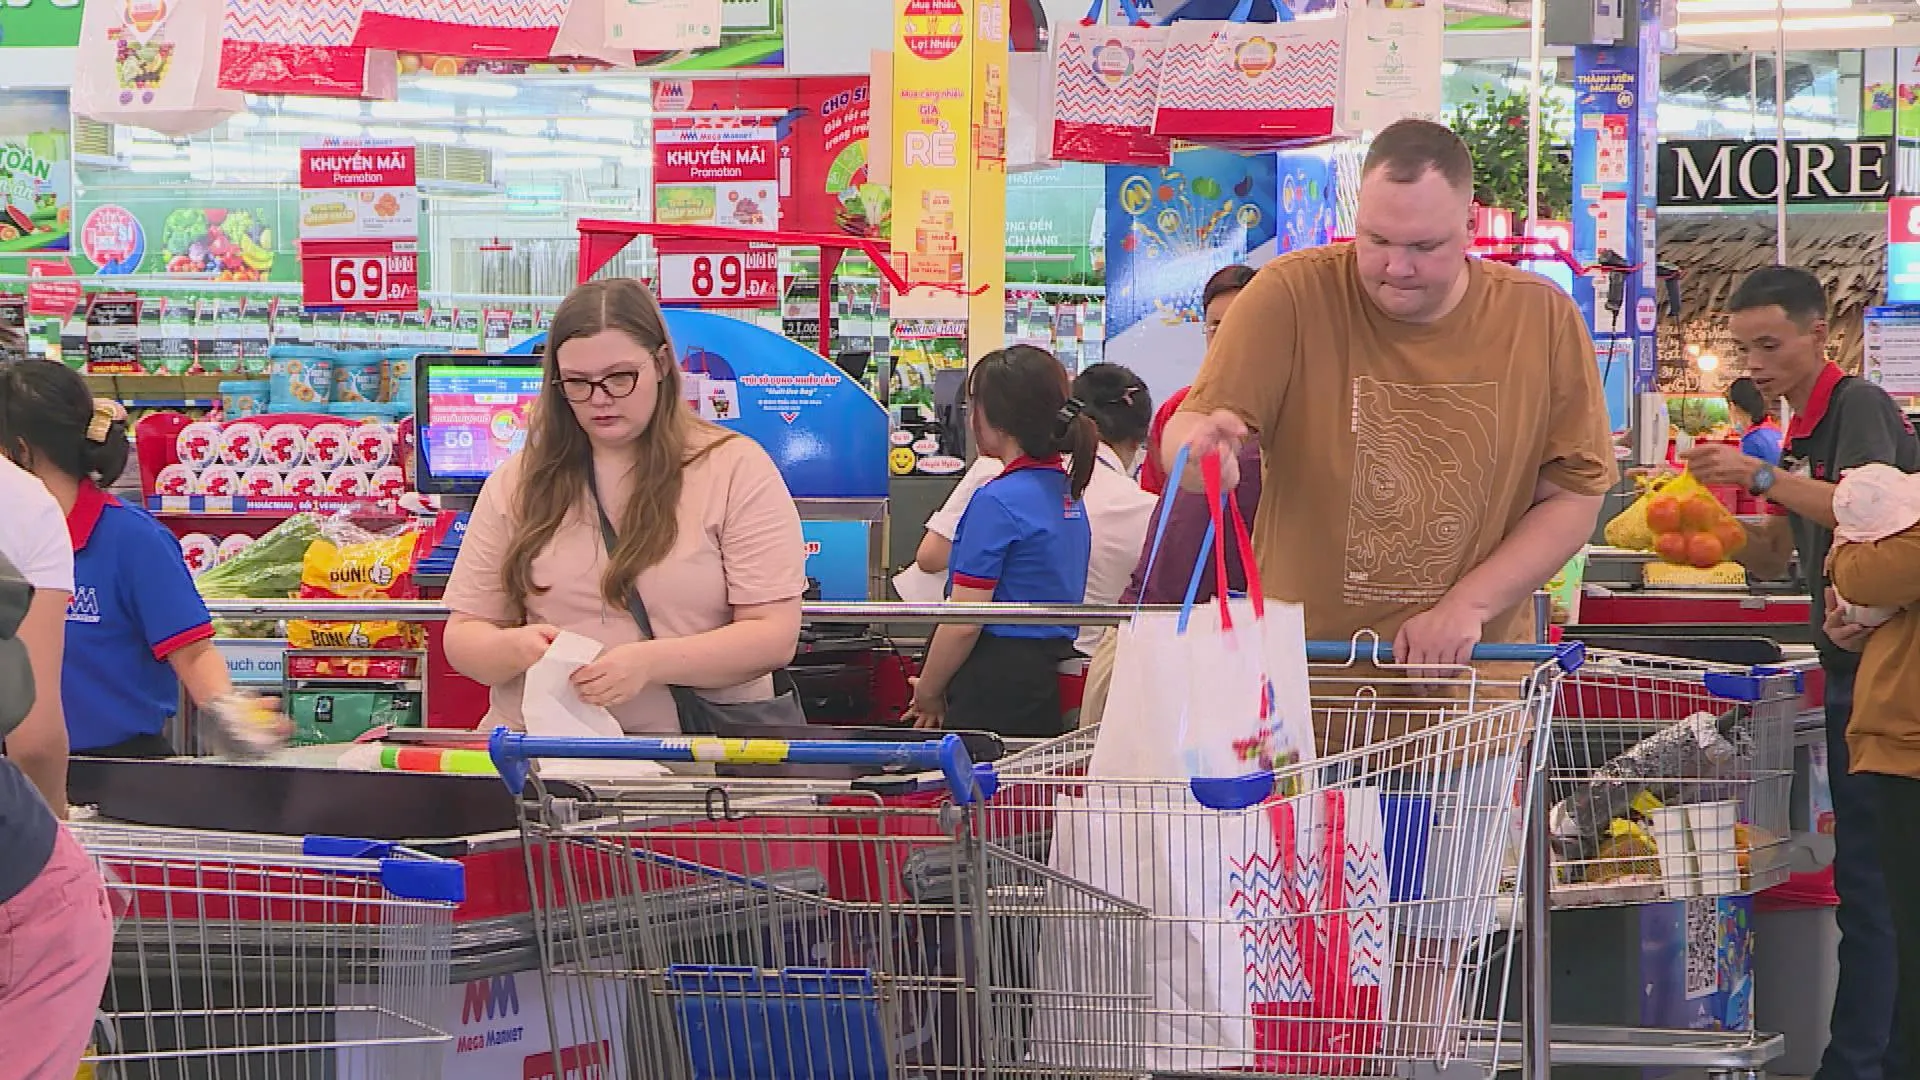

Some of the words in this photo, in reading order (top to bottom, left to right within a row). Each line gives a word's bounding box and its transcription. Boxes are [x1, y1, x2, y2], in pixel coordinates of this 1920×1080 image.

[667, 143, 731, 166] KHUYẾN
[736, 145, 766, 163] MÃI
[904, 120, 957, 168] RẺ
[310, 149, 373, 172] KHUYẾN
[377, 151, 406, 170] MÃI
[690, 167, 742, 177] Promotion
[1670, 142, 1890, 200] MORE
[333, 172, 383, 184] Promotion
[335, 259, 383, 299] 69
[692, 255, 741, 297] 89
